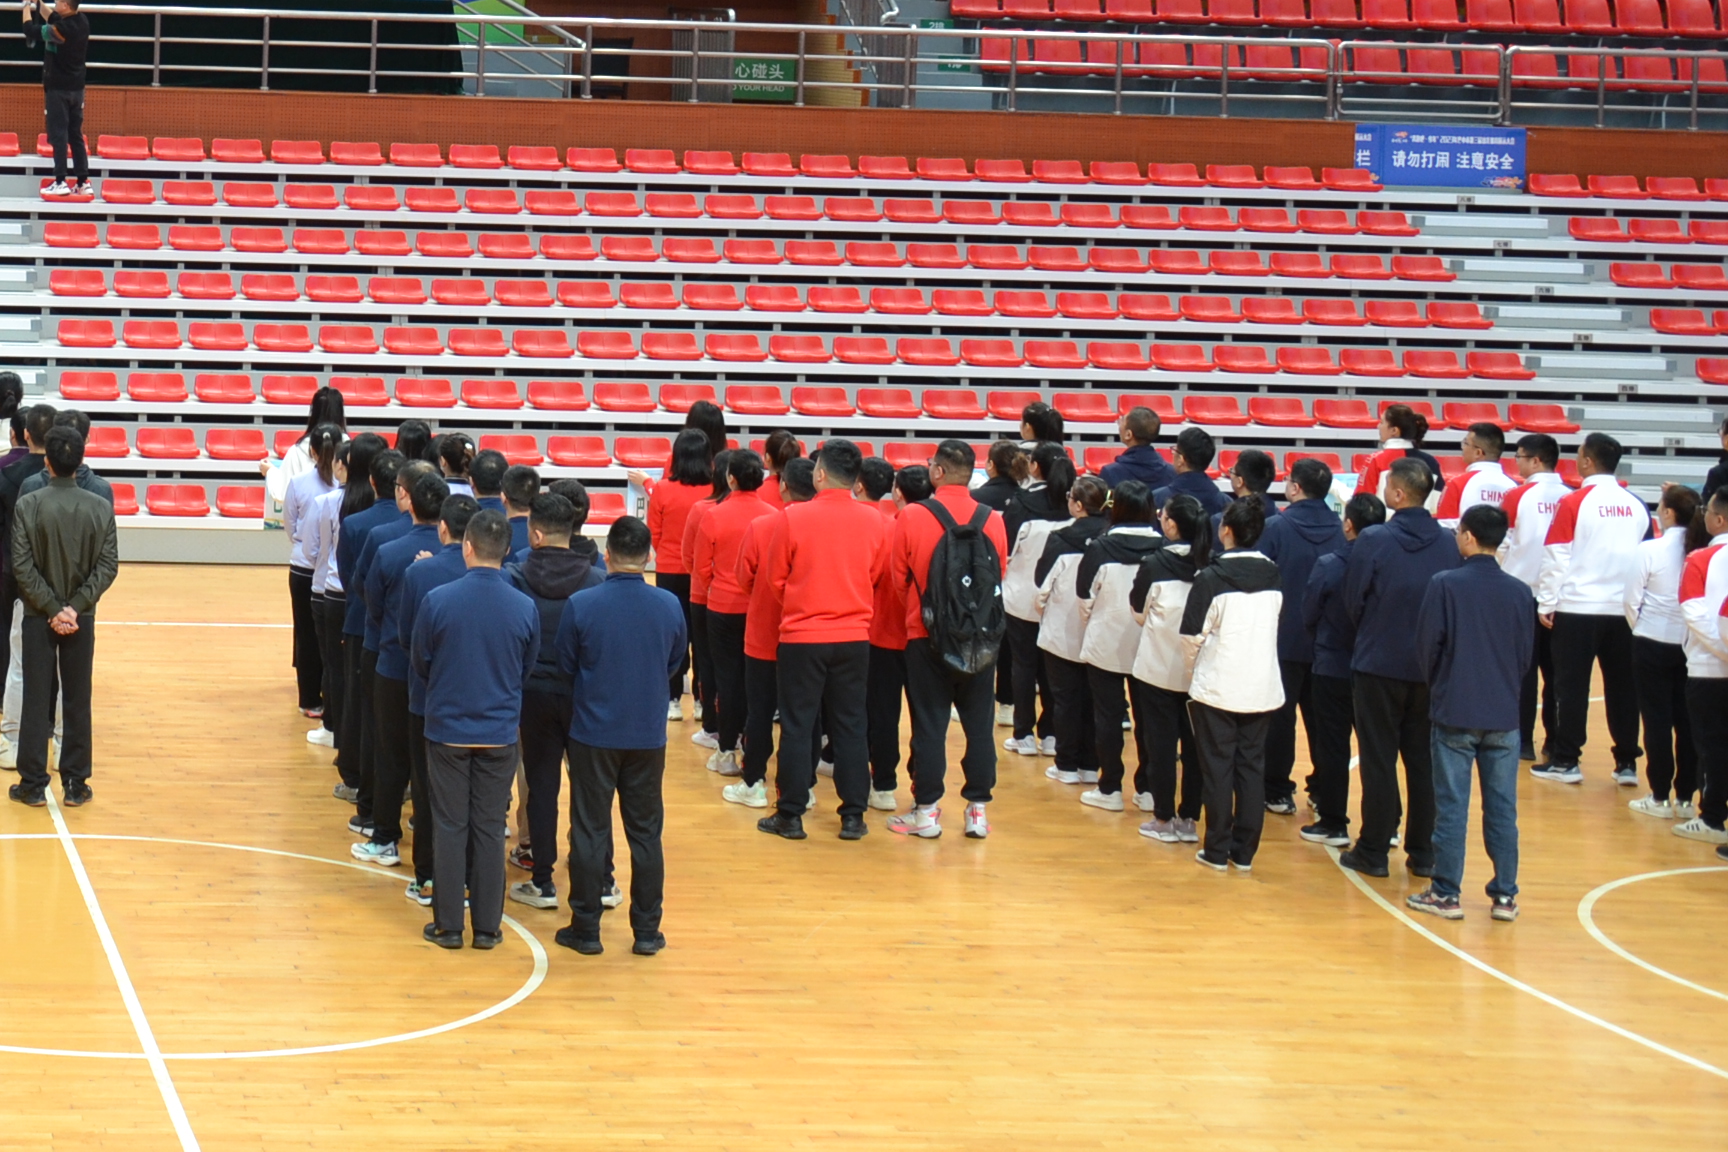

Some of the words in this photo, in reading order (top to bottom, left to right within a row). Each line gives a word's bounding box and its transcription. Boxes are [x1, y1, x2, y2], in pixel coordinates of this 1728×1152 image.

[734, 62, 785, 79] 心碰头
[1391, 149, 1450, 169] 请勿打闹
[1456, 151, 1515, 170] 注意安全
[1598, 505, 1633, 518] CHINA
